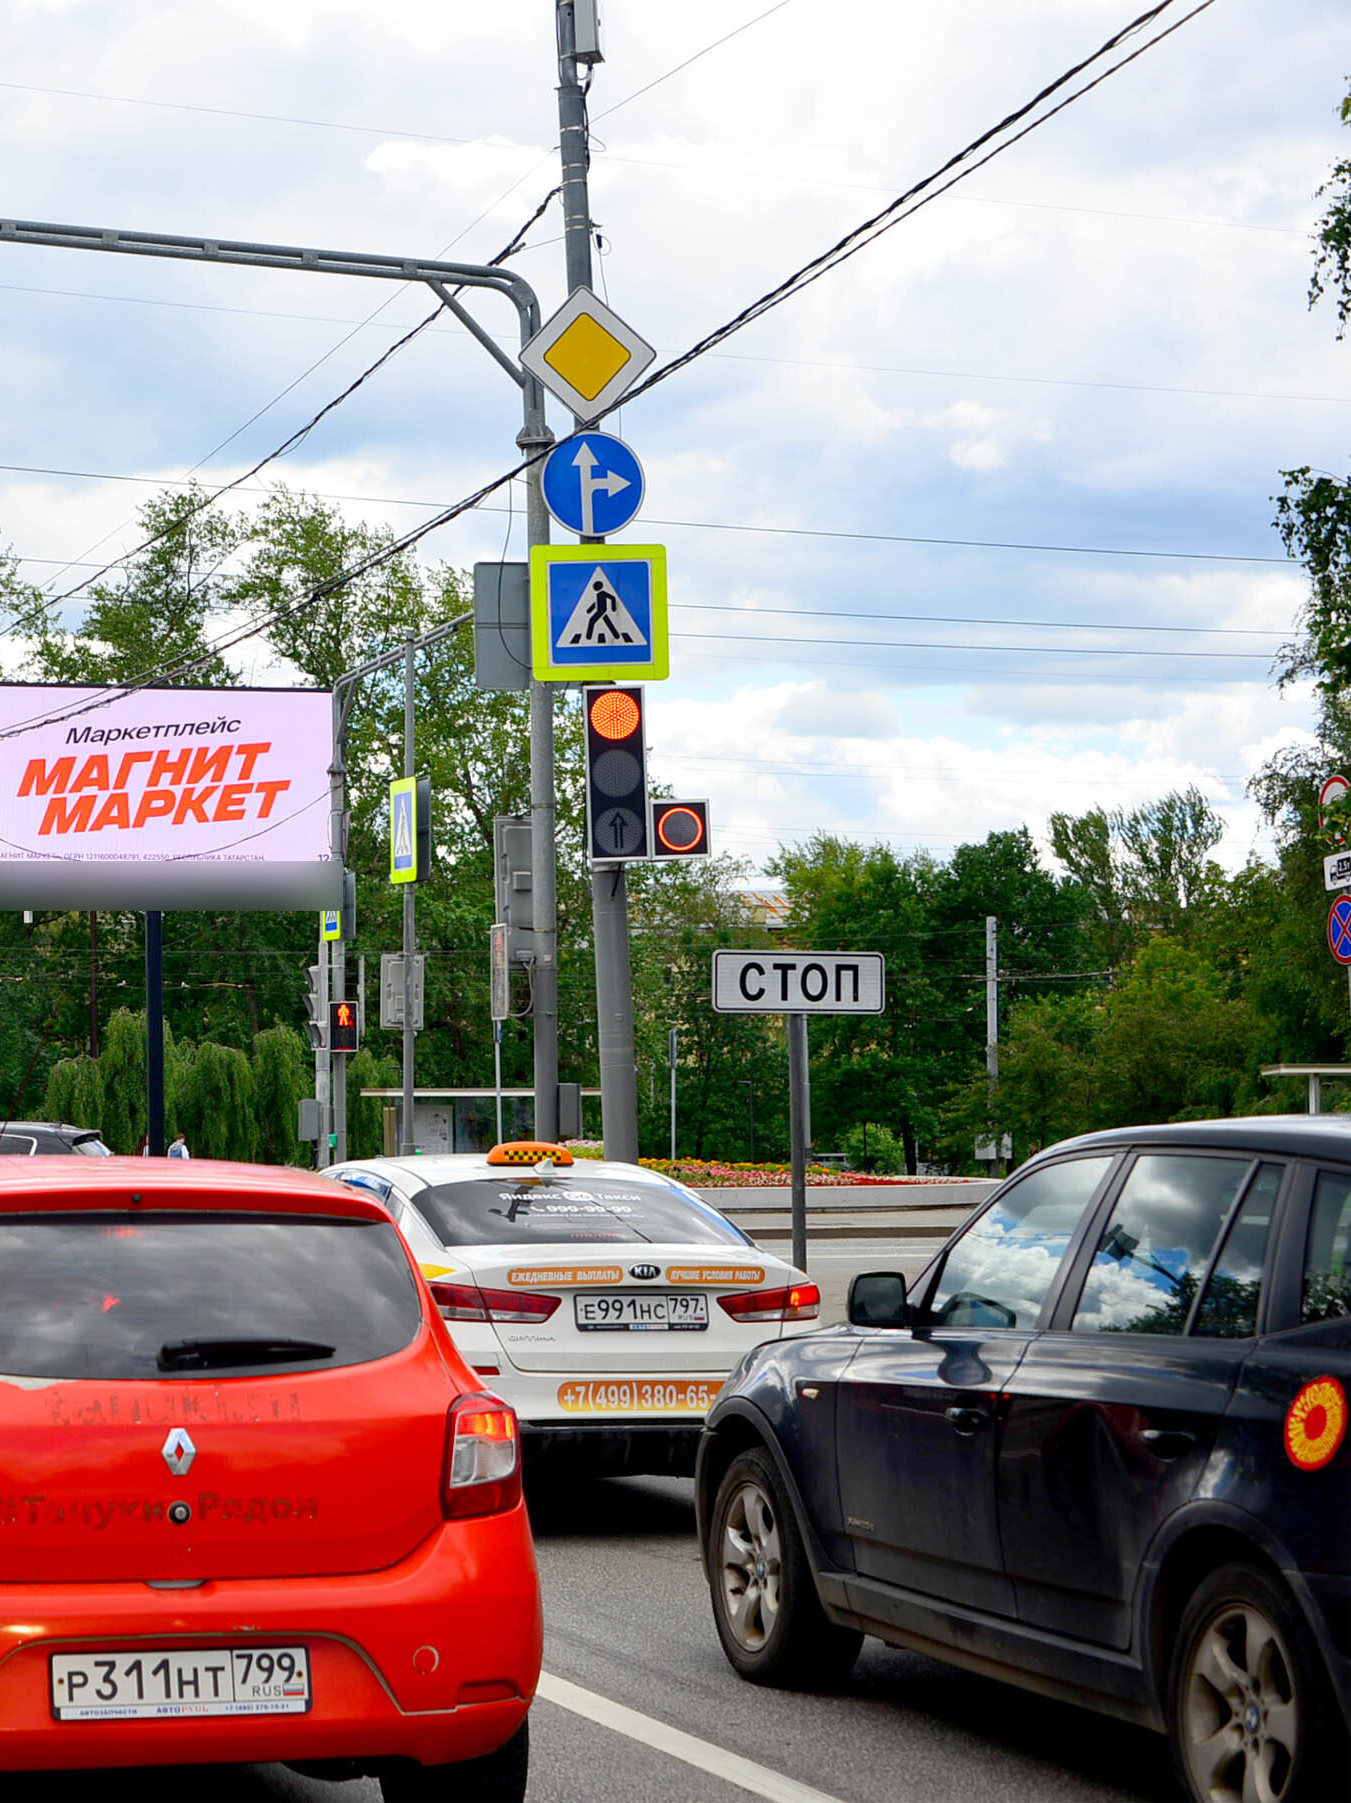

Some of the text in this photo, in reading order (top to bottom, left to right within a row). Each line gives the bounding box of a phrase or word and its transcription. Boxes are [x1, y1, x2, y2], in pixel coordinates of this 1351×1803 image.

[65, 716, 242, 746] Маркетплейс
[17, 742, 272, 797] МАГНИТ
[38, 780, 292, 836] МАРКЕТ
[739, 962, 859, 1002] СТОП
[499, 1192, 562, 1201] Яндекс
[595, 1193, 641, 1201] Такси
[511, 1269, 619, 1284] ЕЖЕДНЕВНЫЕ ВЫПЛАТЫ
[634, 1266, 657, 1277] KIA
[584, 1298, 699, 1320] Е991НС 797
[66, 1653, 296, 1703] Р311НТ 799
[252, 1685, 282, 1697] RUS
